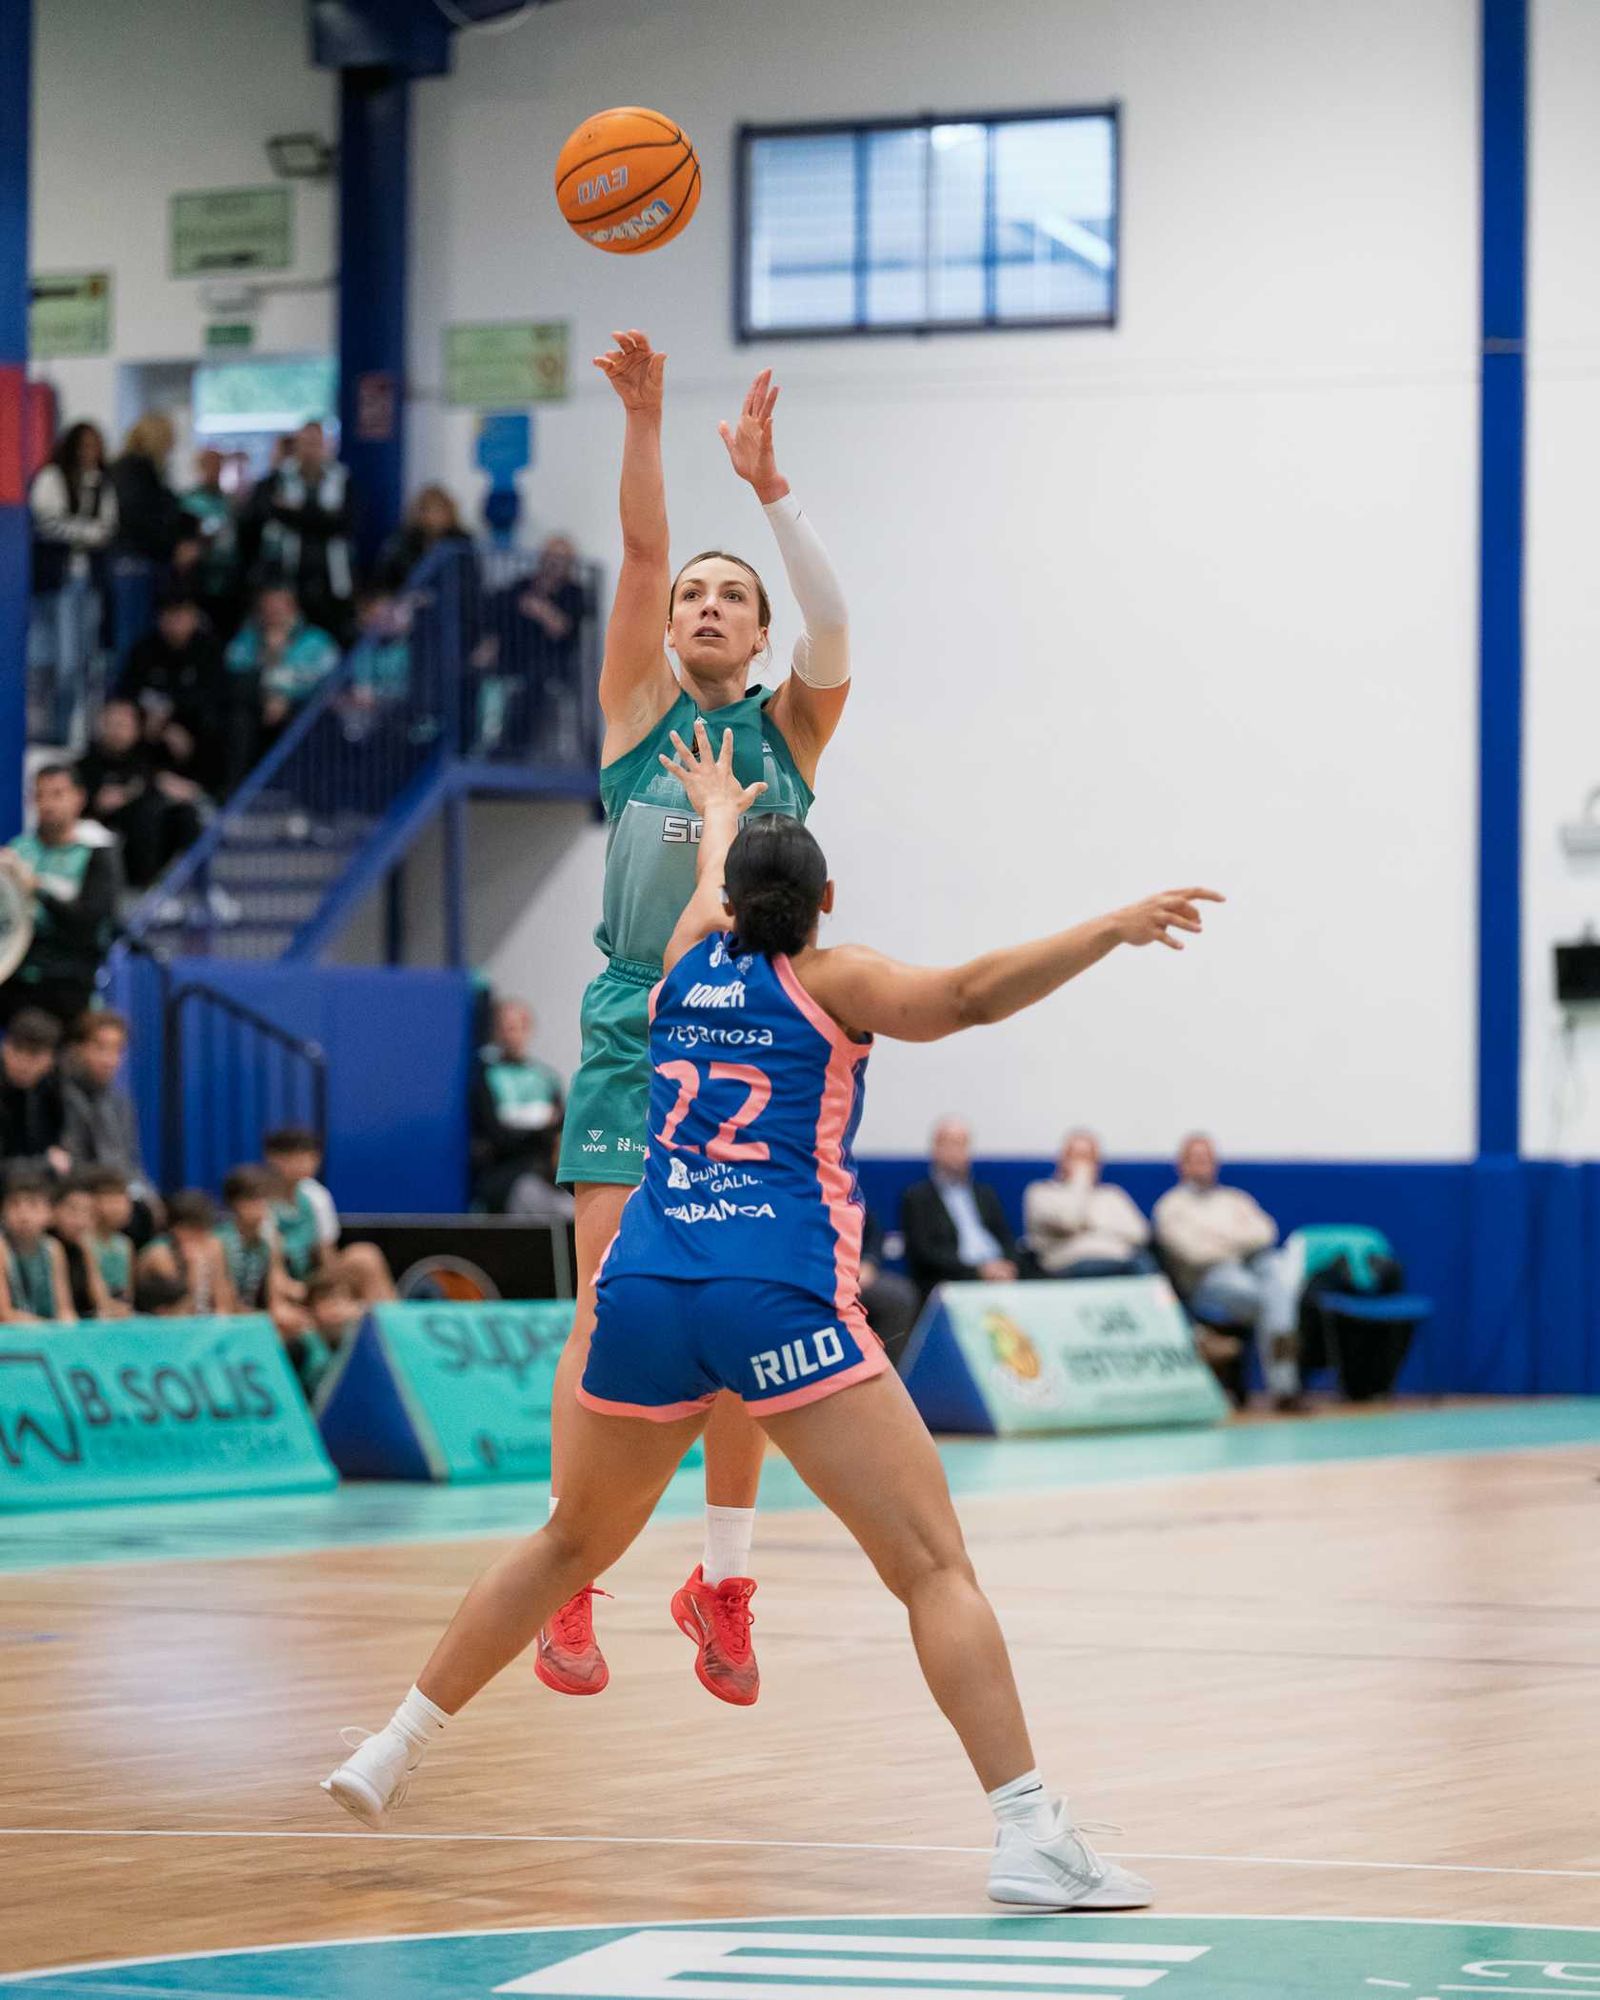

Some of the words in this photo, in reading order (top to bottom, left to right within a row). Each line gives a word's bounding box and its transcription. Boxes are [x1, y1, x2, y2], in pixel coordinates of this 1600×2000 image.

[578, 165, 628, 205] EVO
[654, 1059, 772, 1162] 22
[582, 1143, 607, 1152] vive
[632, 1144, 648, 1153] Ho
[750, 1326, 845, 1390] RILO
